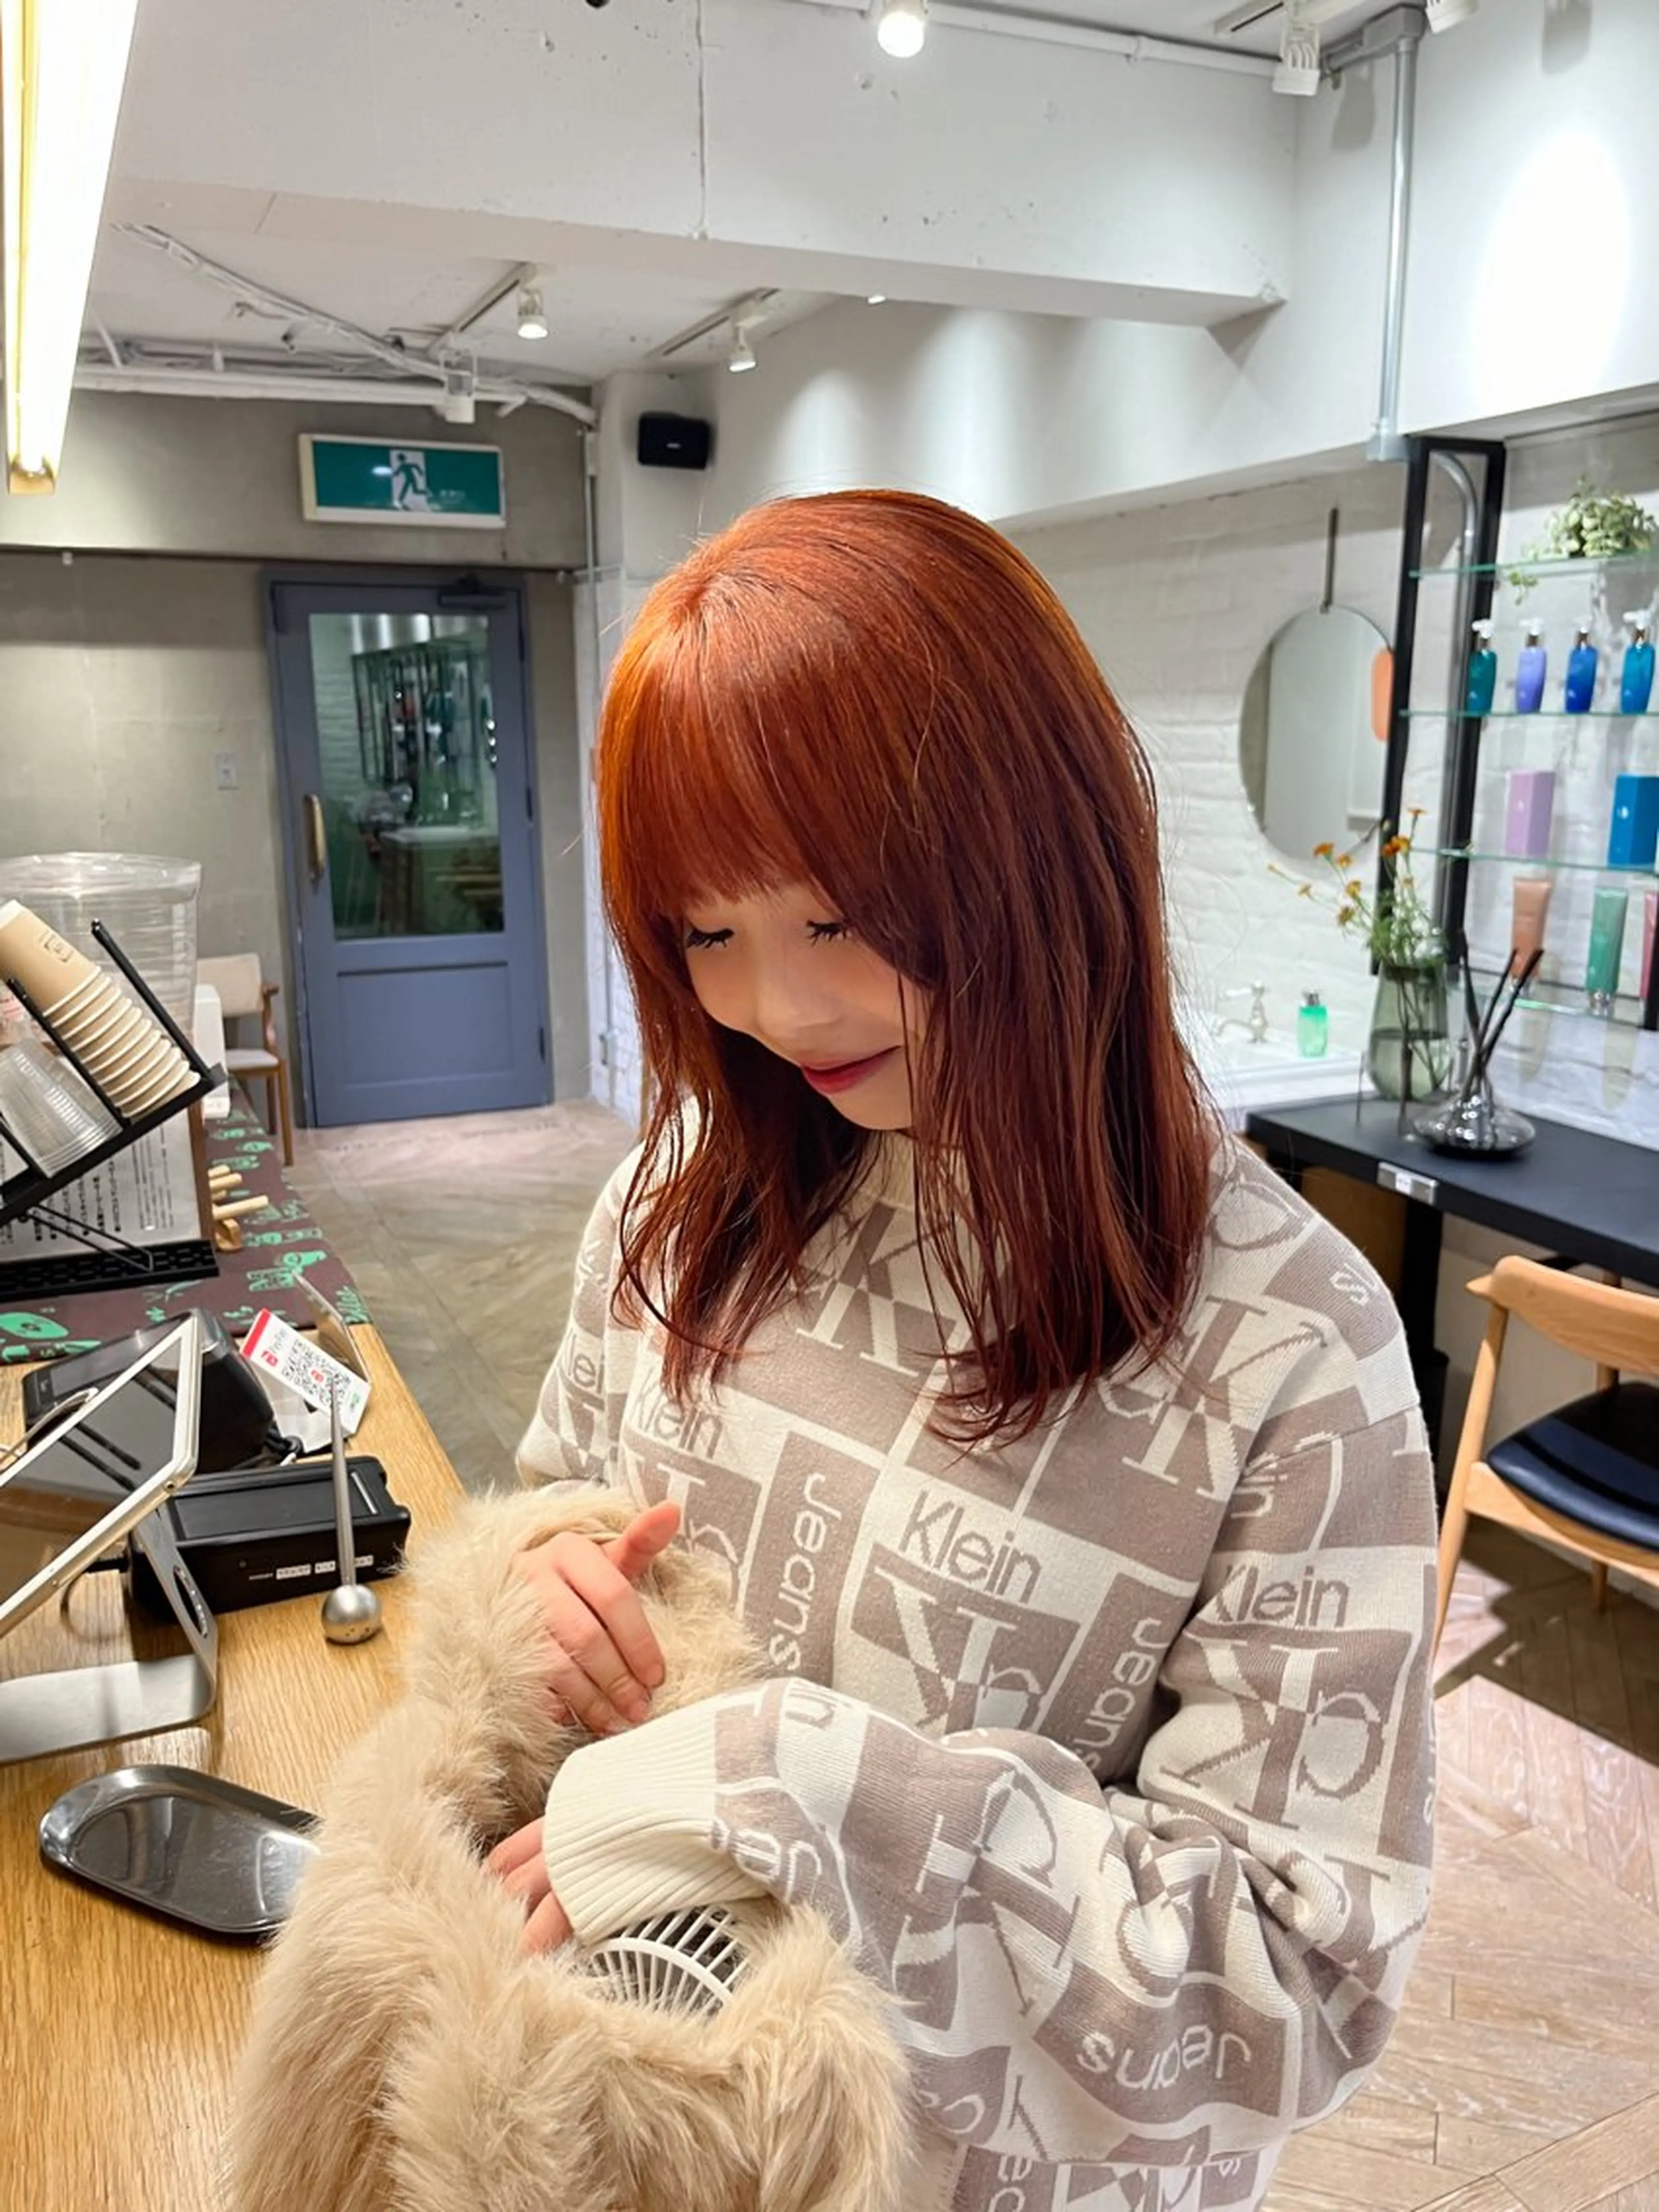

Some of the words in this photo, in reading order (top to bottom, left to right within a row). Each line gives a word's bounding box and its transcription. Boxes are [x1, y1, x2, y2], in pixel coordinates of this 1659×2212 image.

[769, 1472, 842, 1670] Jeans
[898, 1489, 1042, 1604] Klein
[1216, 1564, 1350, 1627] Klein
[1076, 2024, 1251, 2090] Jeans
